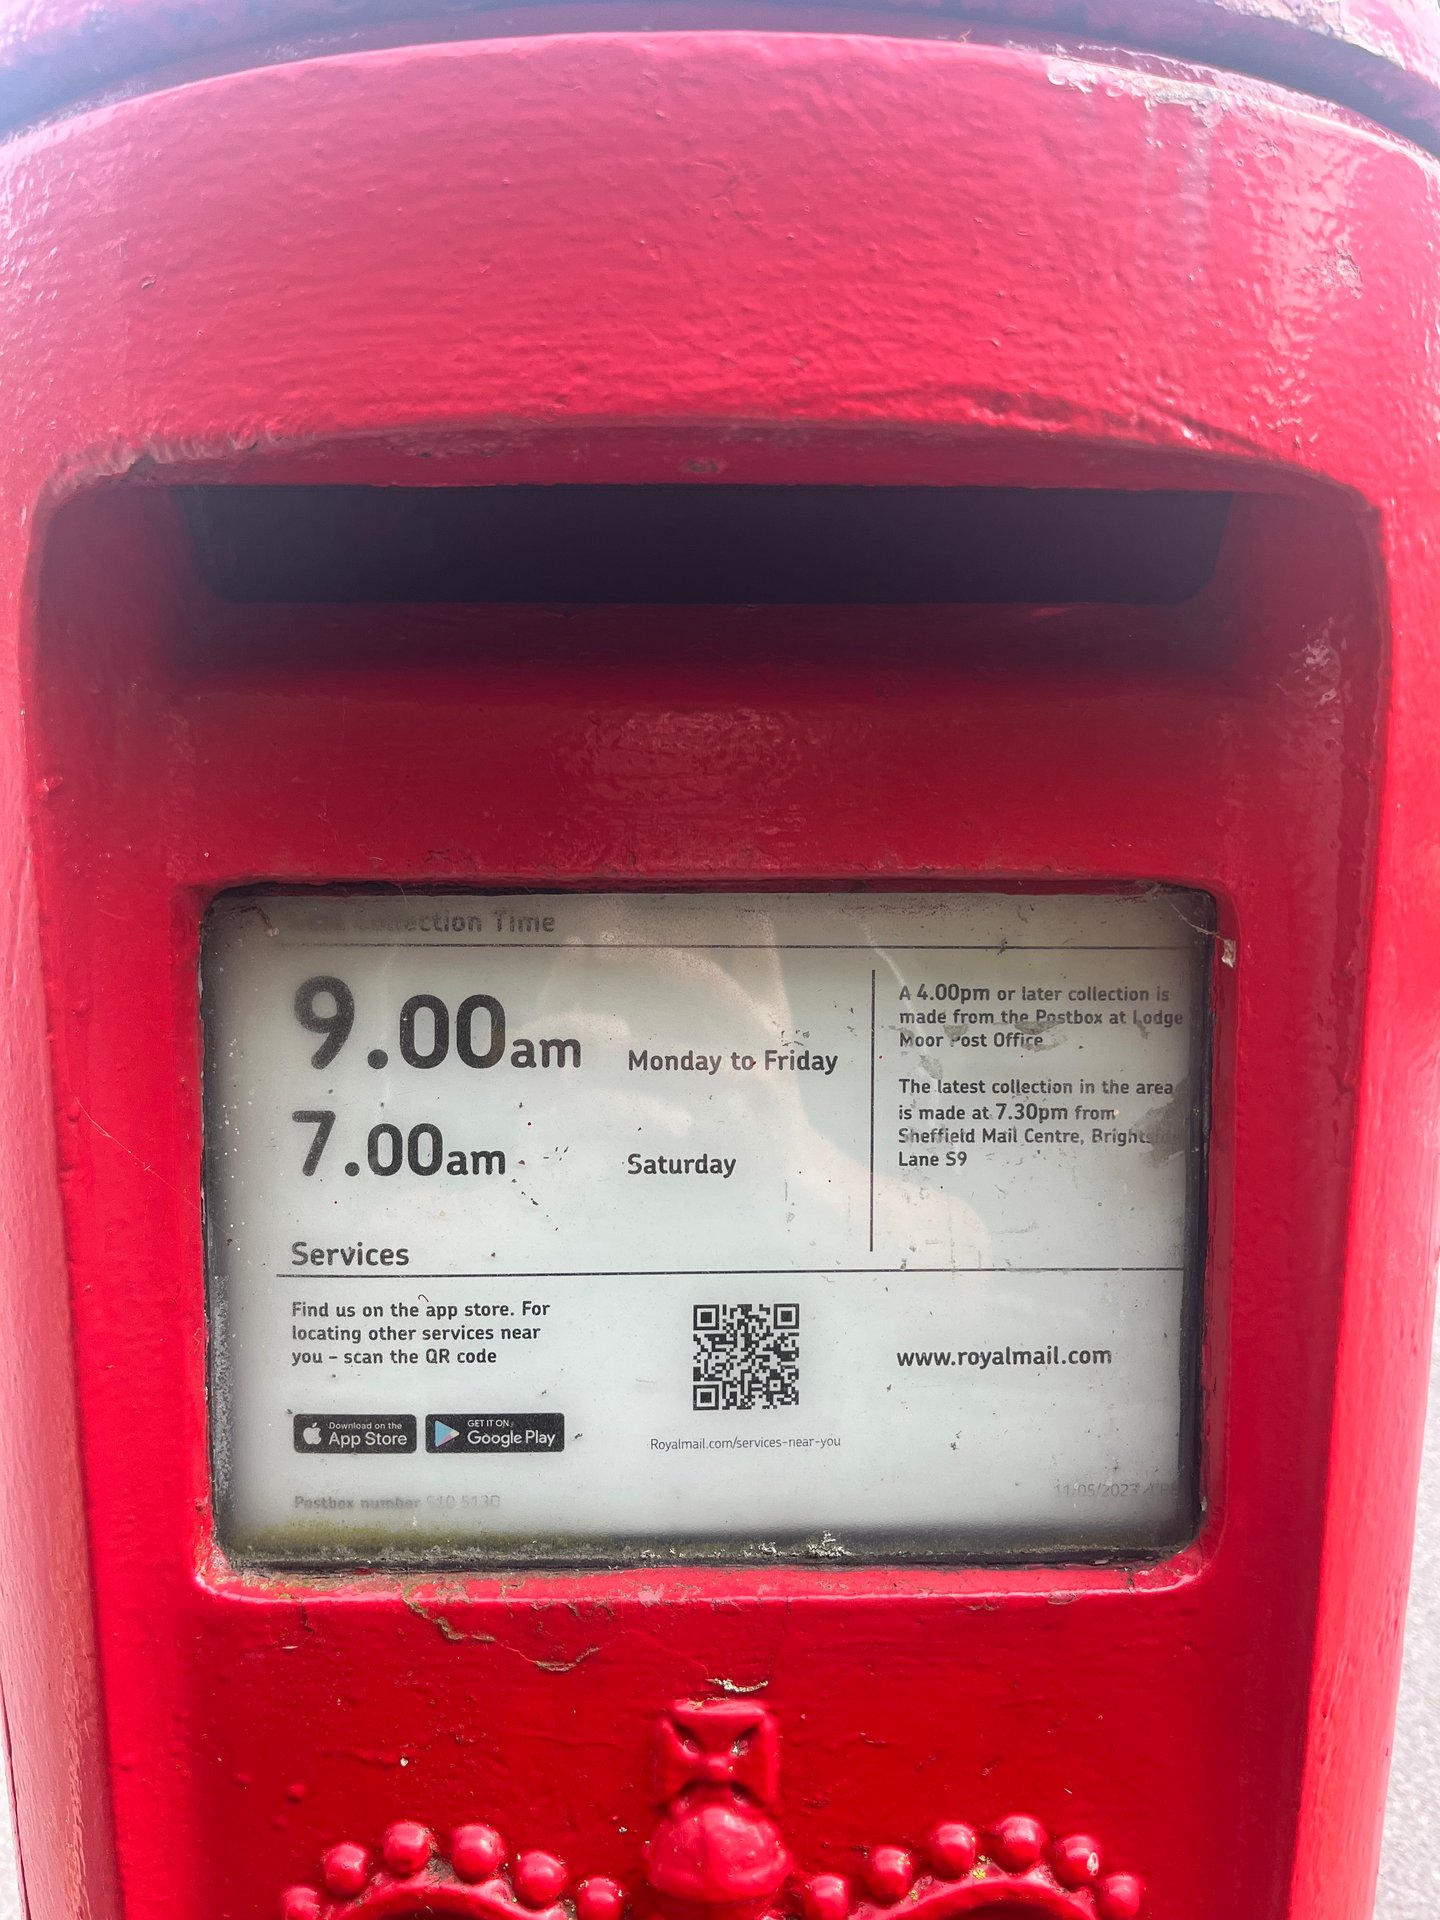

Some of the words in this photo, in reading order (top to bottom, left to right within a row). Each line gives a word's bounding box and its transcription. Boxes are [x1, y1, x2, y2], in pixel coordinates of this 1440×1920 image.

[357, 913, 482, 932] ection
[494, 911, 556, 932] Time
[900, 985, 911, 1000] A
[916, 983, 989, 1004] 4.00pm
[997, 989, 1015, 1001] or
[1022, 986, 1063, 1001] later
[1068, 986, 1149, 1001] collection
[1156, 986, 1169, 1001] is
[294, 975, 582, 1070] 9.00am
[900, 1009, 946, 1024] made
[953, 1009, 994, 1024] from
[1001, 1010, 1028, 1024] the
[1036, 1009, 1102, 1024] Postbox
[1109, 1011, 1126, 1024] at
[900, 1033, 944, 1047] Moor
[994, 1033, 1043, 1047] Office
[628, 1050, 722, 1075] Monday
[731, 1052, 756, 1070] to
[764, 1050, 838, 1075] Friday
[899, 1079, 930, 1093] The
[937, 1079, 985, 1094] latest
[992, 1079, 1072, 1094] collection
[1080, 1079, 1094, 1093] in
[1102, 1080, 1129, 1094] the
[1136, 1082, 1173, 1094] area
[899, 1105, 912, 1120] is
[919, 1105, 966, 1120] made
[972, 1107, 989, 1120] at
[995, 1103, 1068, 1123] 7.30pm
[1075, 1105, 1115, 1120] from
[292, 1110, 505, 1177] 7.00am
[898, 1128, 975, 1143] Sheffield
[982, 1128, 1017, 1143] Mail
[1024, 1128, 1084, 1145] Centre,
[628, 1153, 736, 1178] Saturday
[899, 1152, 939, 1166] Lane
[946, 1151, 967, 1166] S9
[291, 1241, 410, 1266] Services
[292, 1302, 329, 1317] Find
[336, 1305, 355, 1317] us
[363, 1304, 384, 1317] on
[390, 1303, 419, 1317] the
[426, 1304, 457, 1320] app
[464, 1303, 514, 1316] store.
[522, 1301, 550, 1316] For
[292, 1326, 361, 1344] locating
[369, 1326, 416, 1341] other
[422, 1325, 494, 1340] services
[501, 1327, 540, 1340] near
[291, 1352, 323, 1367] you
[344, 1352, 383, 1364] scan
[390, 1350, 418, 1364] the
[426, 1349, 450, 1364] QR
[457, 1349, 497, 1363] code
[897, 1345, 1112, 1369] www.royalmail.com
[329, 1422, 373, 1430] Download
[329, 1434, 361, 1448] App
[365, 1433, 407, 1446] Store
[467, 1430, 522, 1447] Google
[526, 1430, 555, 1447] Play
[650, 1436, 841, 1452] Royalmail.com/services-near-you
[294, 1496, 354, 1509] Postbox
[361, 1497, 421, 1509] number
